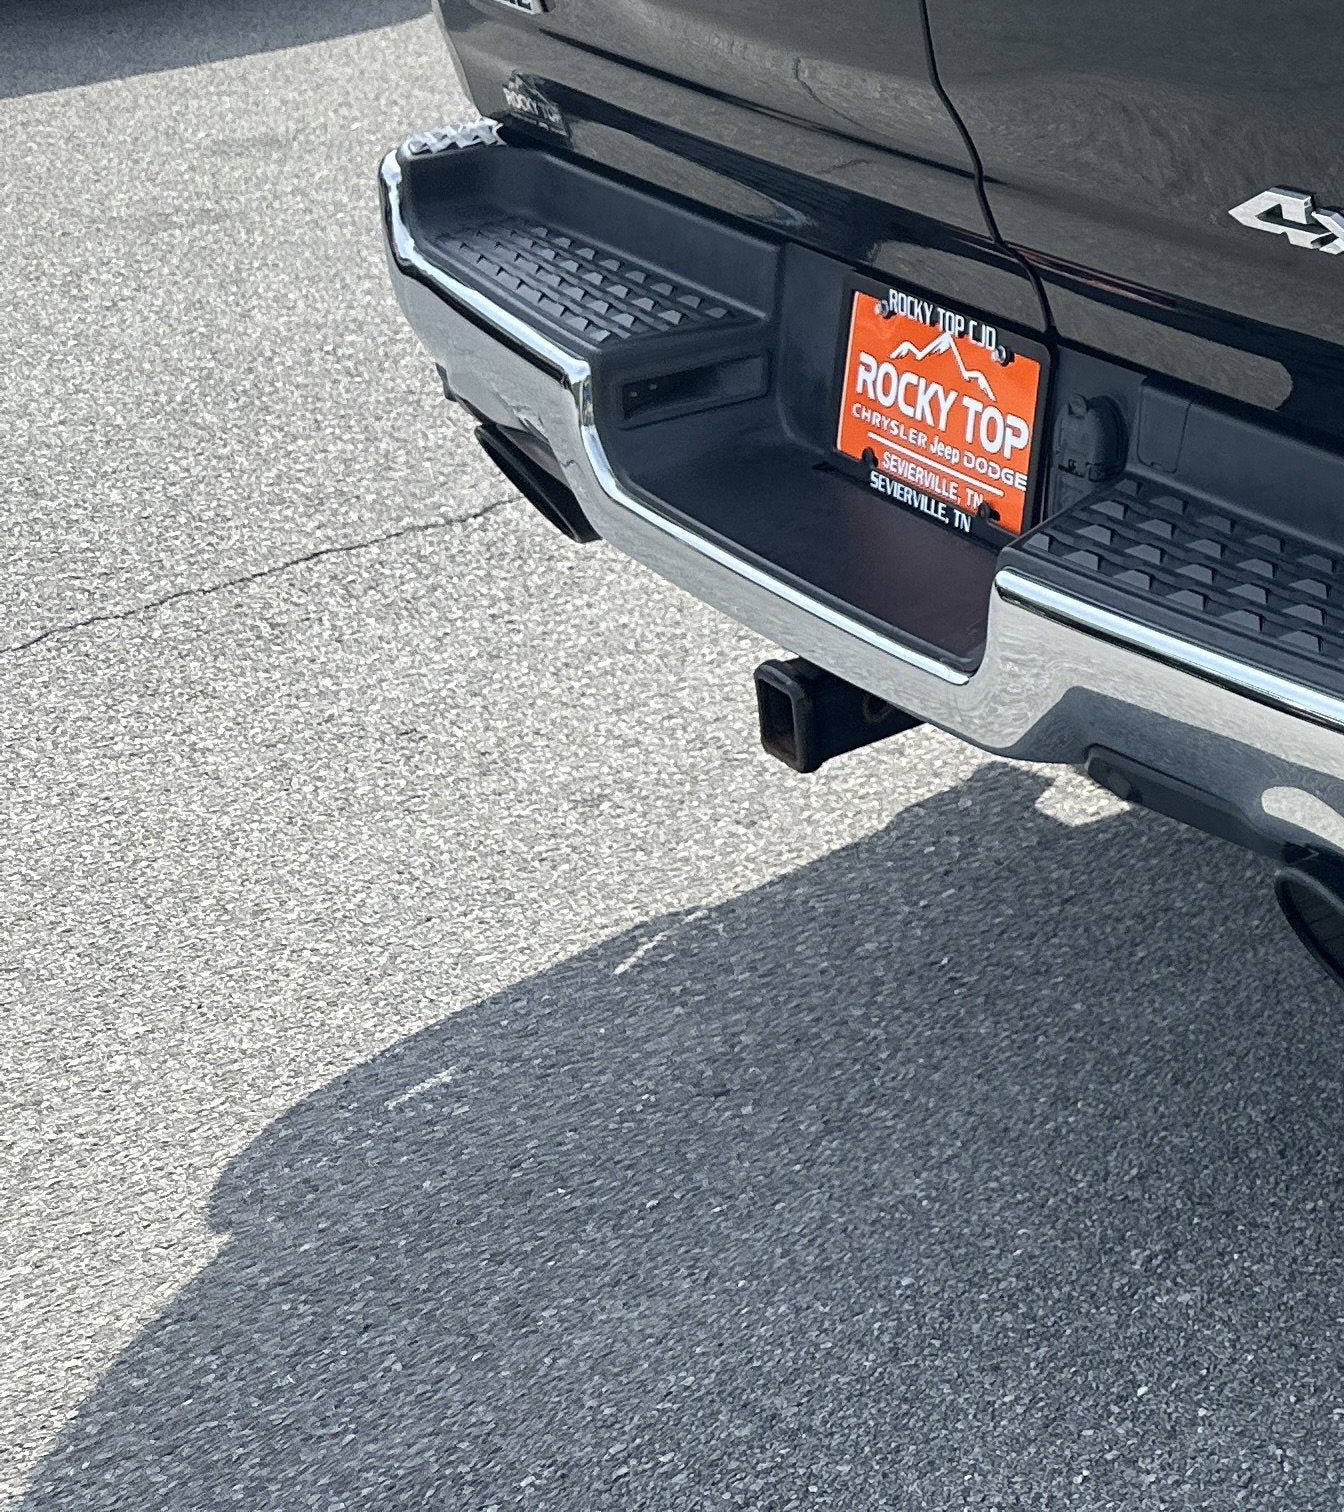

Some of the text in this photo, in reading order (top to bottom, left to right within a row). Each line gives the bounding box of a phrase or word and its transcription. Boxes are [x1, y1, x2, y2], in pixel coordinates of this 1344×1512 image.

[888, 288, 998, 352] ROCKY TOP CJD
[855, 351, 1029, 460] ROCKY TOP
[852, 401, 1029, 492] CHRYSLER Jeep DODGE
[869, 470, 973, 534] SEVIERVILLE, TN
[881, 450, 984, 509] SEVIERVILLE, TN
